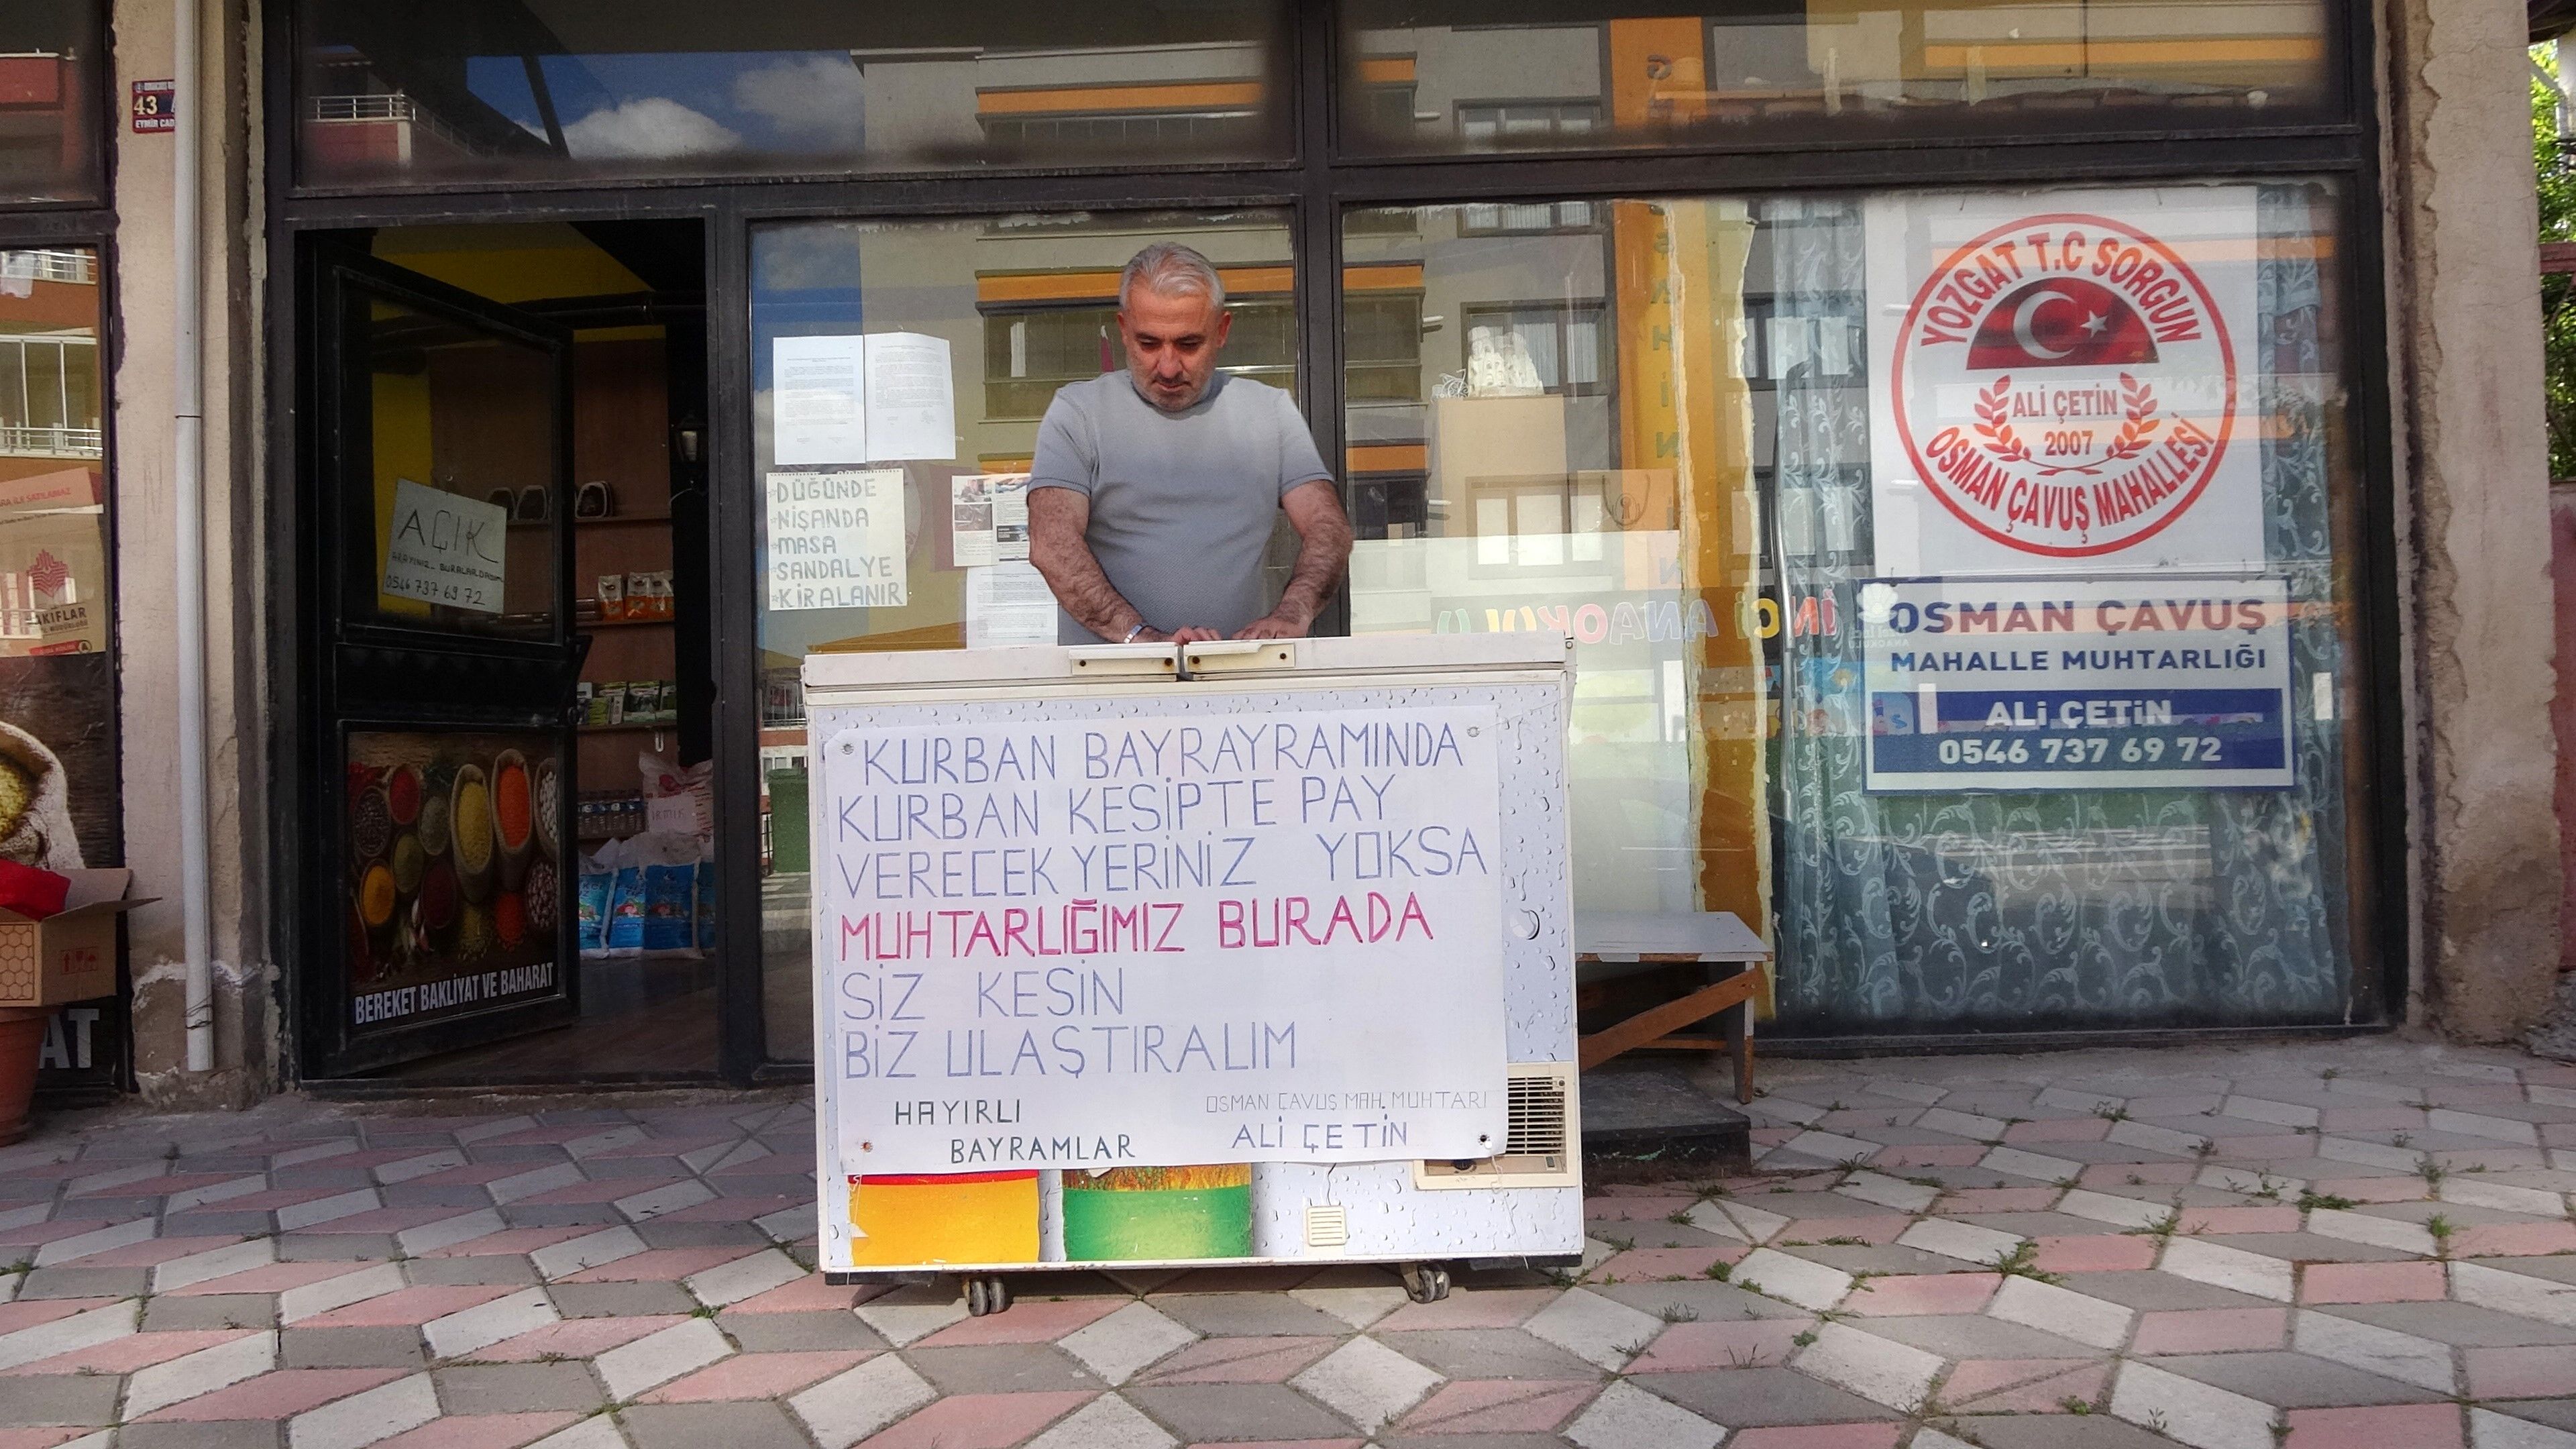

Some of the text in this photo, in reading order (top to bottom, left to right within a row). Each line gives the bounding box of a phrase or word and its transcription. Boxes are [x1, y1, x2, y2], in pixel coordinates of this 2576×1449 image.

[133, 95, 158, 115] 43
[1921, 230, 2202, 347] YOZGAT T.C SORGUN
[2012, 382, 2118, 424] ALİ ÇETİN
[2044, 429, 2095, 457] 2007
[777, 478, 877, 504] DÜĞÜNDE
[1926, 411, 2216, 544] OSMAN ÇAVUŞ MAHALLESİ
[777, 506, 869, 531] NİŞANDA
[398, 509, 499, 564] AÇIK
[777, 535, 837, 555] MASA
[775, 555, 893, 581] SANDALYE
[415, 579, 439, 596] 737
[444, 585, 458, 600] 69
[464, 588, 486, 606] 72
[778, 582, 904, 608] KİRALANIR
[35, 606, 88, 626] AKIFLAR
[1889, 599, 2267, 635] OSMAN ÇAVUŞ
[1891, 644, 2267, 672] MAHALLE MUHTARLIĞI
[864, 721, 1464, 786] KURBAN BAYRAYRAMINDA
[1938, 737, 2222, 765] 0546 737 69 72
[839, 773, 1397, 843] KURBAN KESİPTE PAY
[837, 826, 1488, 900] VERECEK YERİNİZ YOKSA
[841, 891, 1434, 962] MUHTARLIĞIMIZ BURADA
[354, 961, 554, 1025] BEREKET BAKLİYAT VE BAHARAT
[841, 959, 1124, 1021] SİZ KESİN
[845, 1021, 1295, 1079] BİZ ULAŞTIRALIM
[895, 1098, 1022, 1126] HAYIRLI
[1206, 1090, 1488, 1113] OSMAN ÇAVUŞ MAH. MUHTARI
[1232, 1113, 1407, 1154] ALİ ÇETİN
[951, 1134, 1136, 1164] BAYRAMLAR
